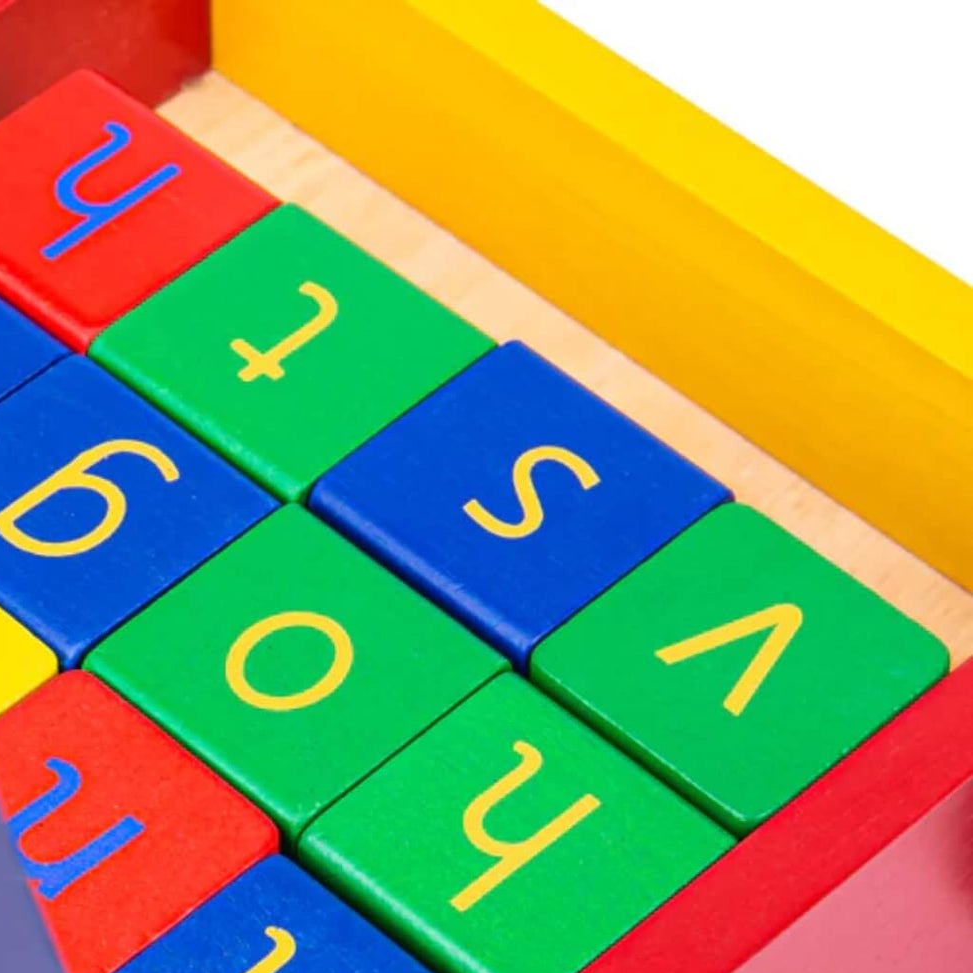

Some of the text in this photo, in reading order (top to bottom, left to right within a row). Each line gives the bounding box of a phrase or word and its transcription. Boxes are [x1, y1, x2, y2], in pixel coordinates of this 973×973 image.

[43, 122, 179, 260] h
[231, 281, 339, 383] t
[463, 446, 600, 539] s
[225, 610, 355, 712] o
[655, 602, 803, 716] v
[4, 756, 146, 901] n
[451, 740, 601, 913] h
